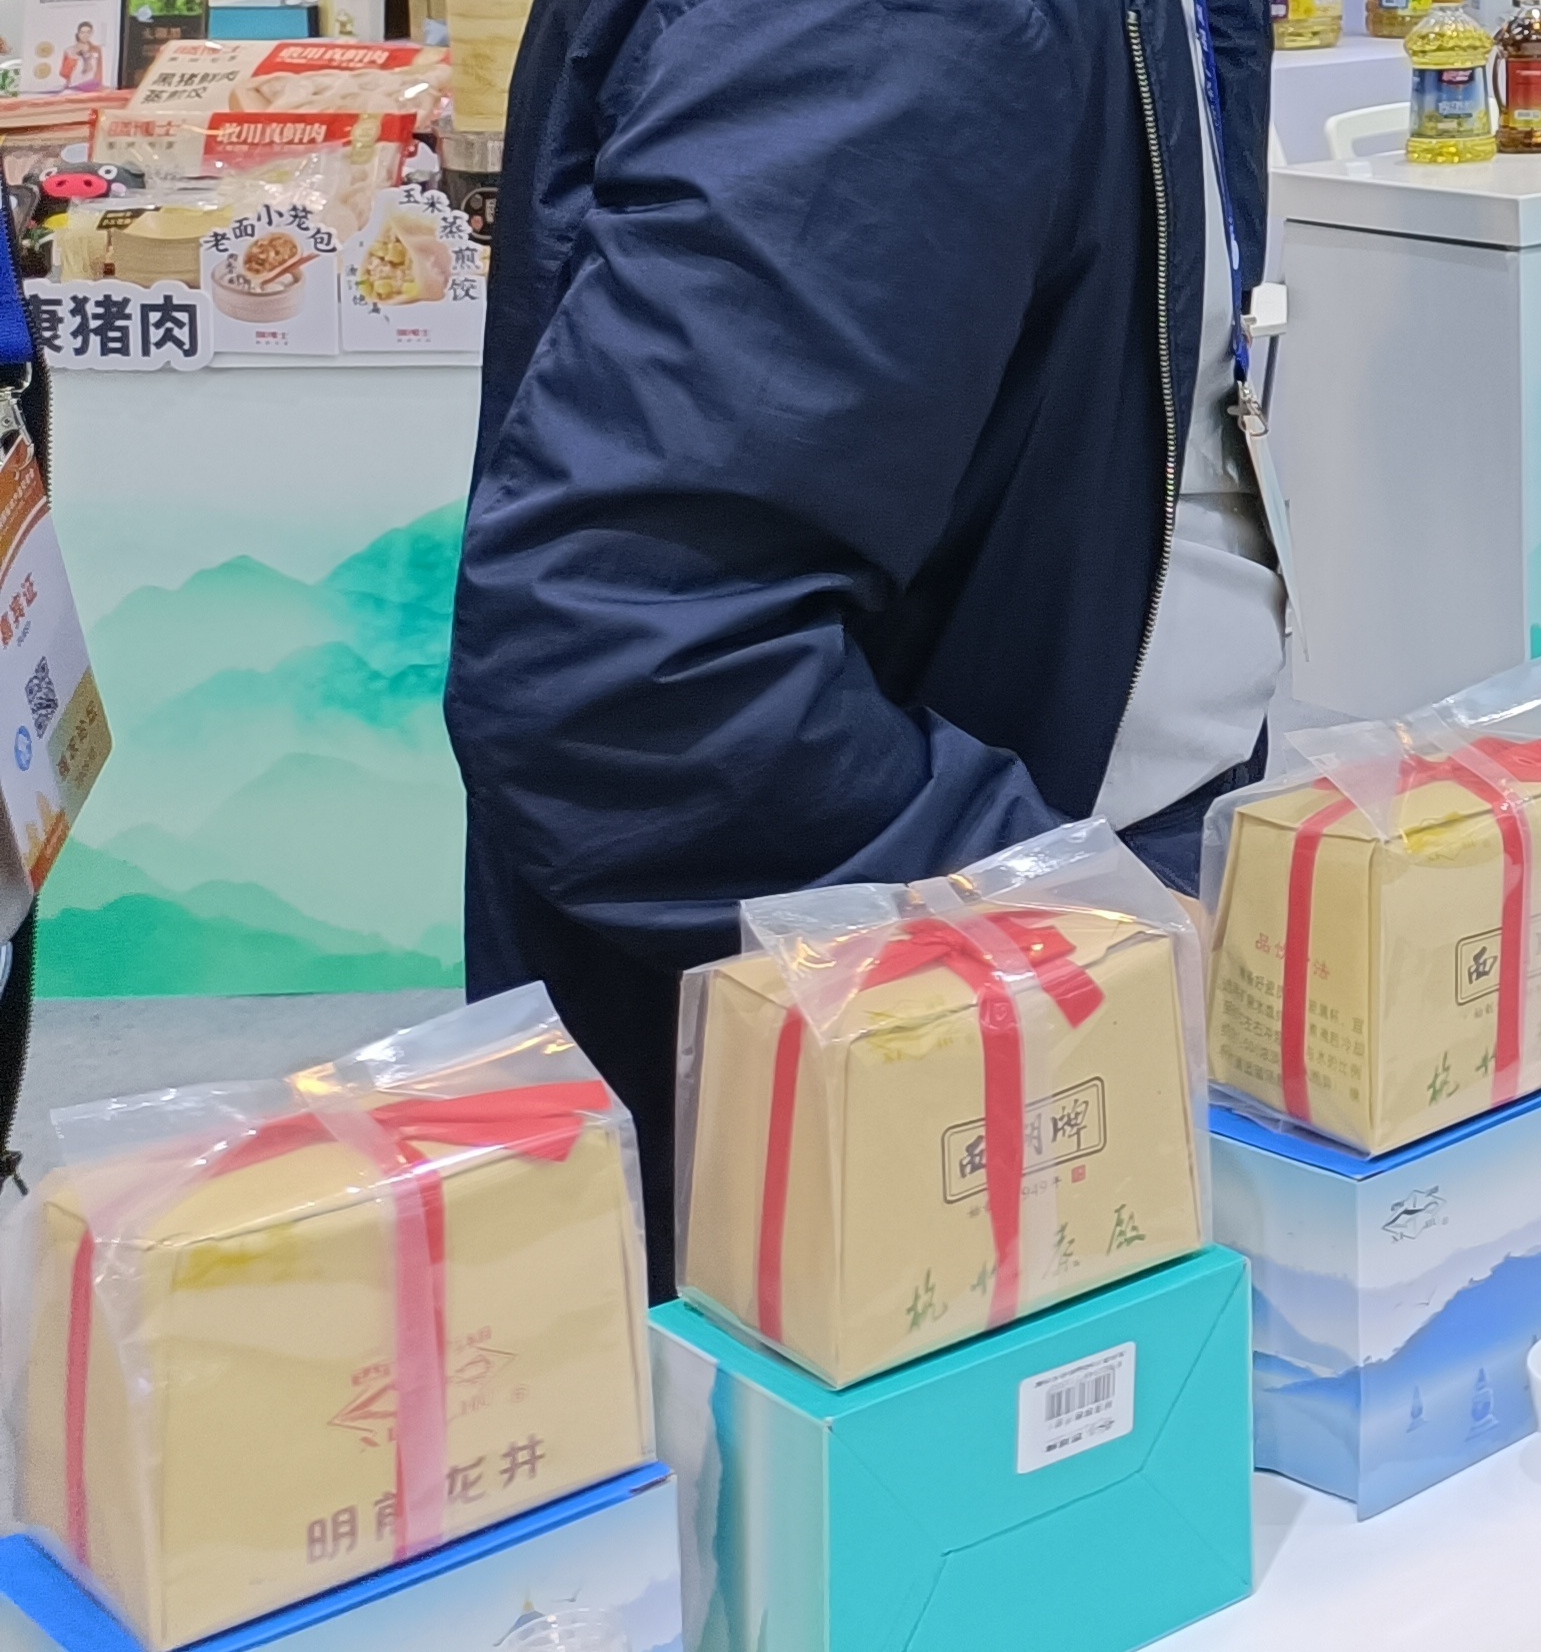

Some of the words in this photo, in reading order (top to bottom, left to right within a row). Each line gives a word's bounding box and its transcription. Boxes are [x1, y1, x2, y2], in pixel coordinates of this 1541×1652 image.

[203, 203, 337, 254] 老面小笼包
[398, 188, 485, 301] 玉米蒸煎饺
[1255, 932, 1330, 981] 品饮法
